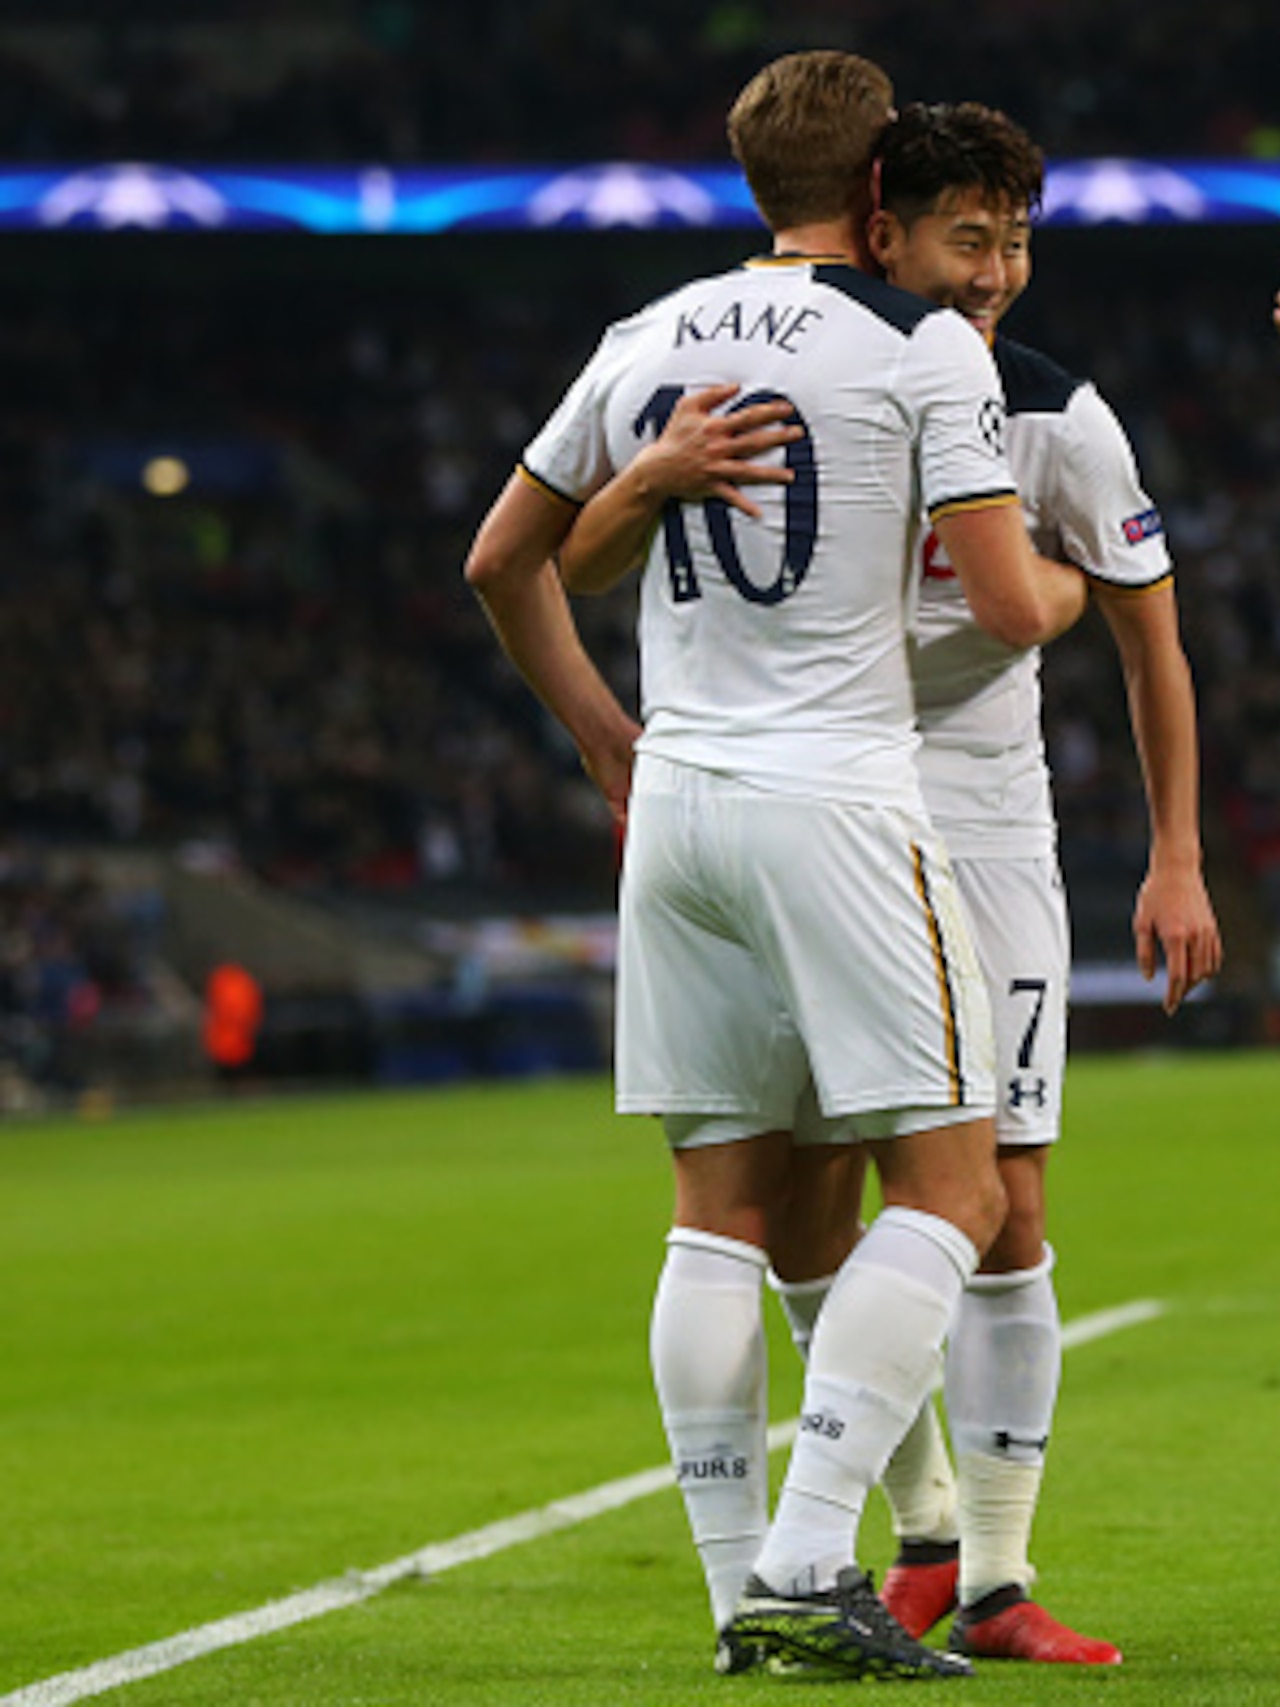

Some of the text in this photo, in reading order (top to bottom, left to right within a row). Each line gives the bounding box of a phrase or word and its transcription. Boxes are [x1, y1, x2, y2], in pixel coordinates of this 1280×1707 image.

[673, 301, 824, 354] KANE
[632, 384, 819, 606] 10
[1009, 979, 1047, 1069] 7
